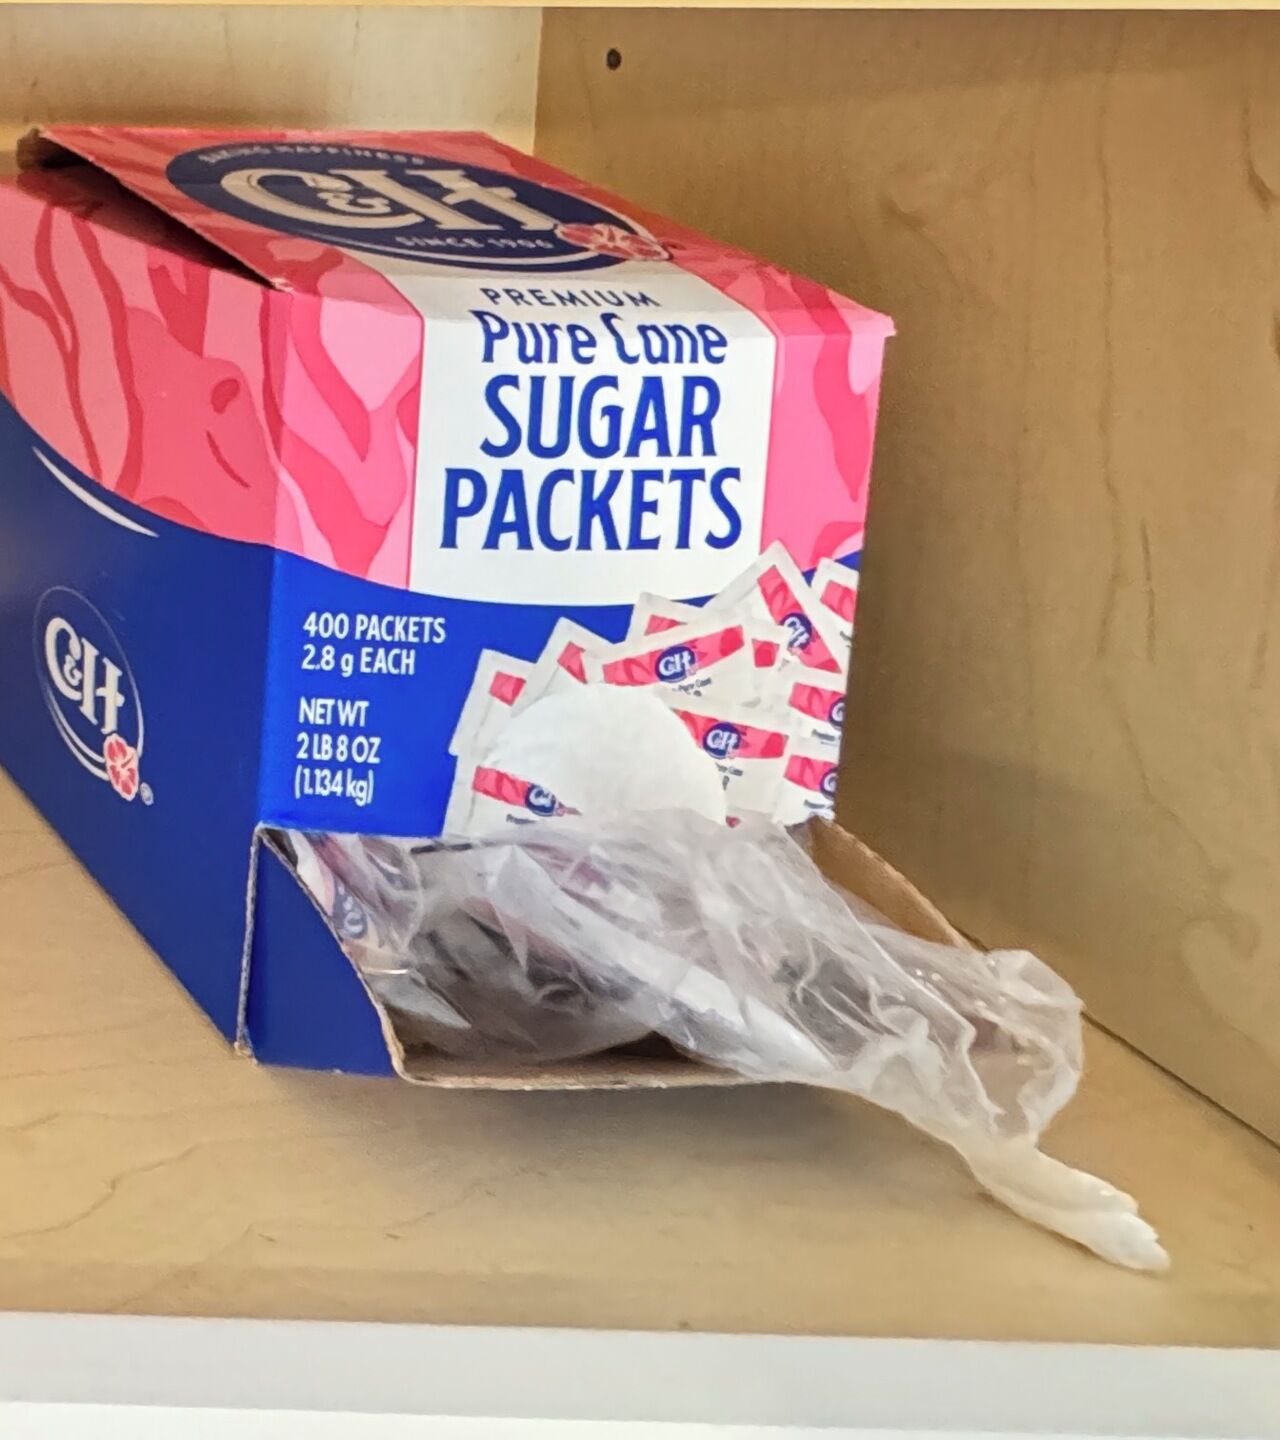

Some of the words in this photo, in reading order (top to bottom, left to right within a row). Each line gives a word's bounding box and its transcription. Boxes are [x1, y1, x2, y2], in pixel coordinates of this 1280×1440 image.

[220, 168, 558, 231] C&H
[395, 236, 484, 248] SINCE
[480, 288, 662, 307] PREMIUM
[468, 310, 597, 364] Pure
[600, 313, 728, 364] Cane
[479, 375, 721, 459] SUGAR
[440, 467, 742, 551] PACKETS
[303, 612, 349, 639] 400
[355, 614, 446, 643] PACKETS
[45, 617, 125, 735] C&H
[301, 644, 335, 671] 2.8
[341, 653, 354, 678] g
[360, 647, 416, 675] EACH
[298, 696, 335, 725] NET
[337, 699, 370, 727] WT
[296, 732, 308, 759] 2
[312, 733, 332, 760] LB
[336, 734, 348, 762] 8
[351, 735, 381, 763] OZ
[346, 768, 374, 806] kg)
